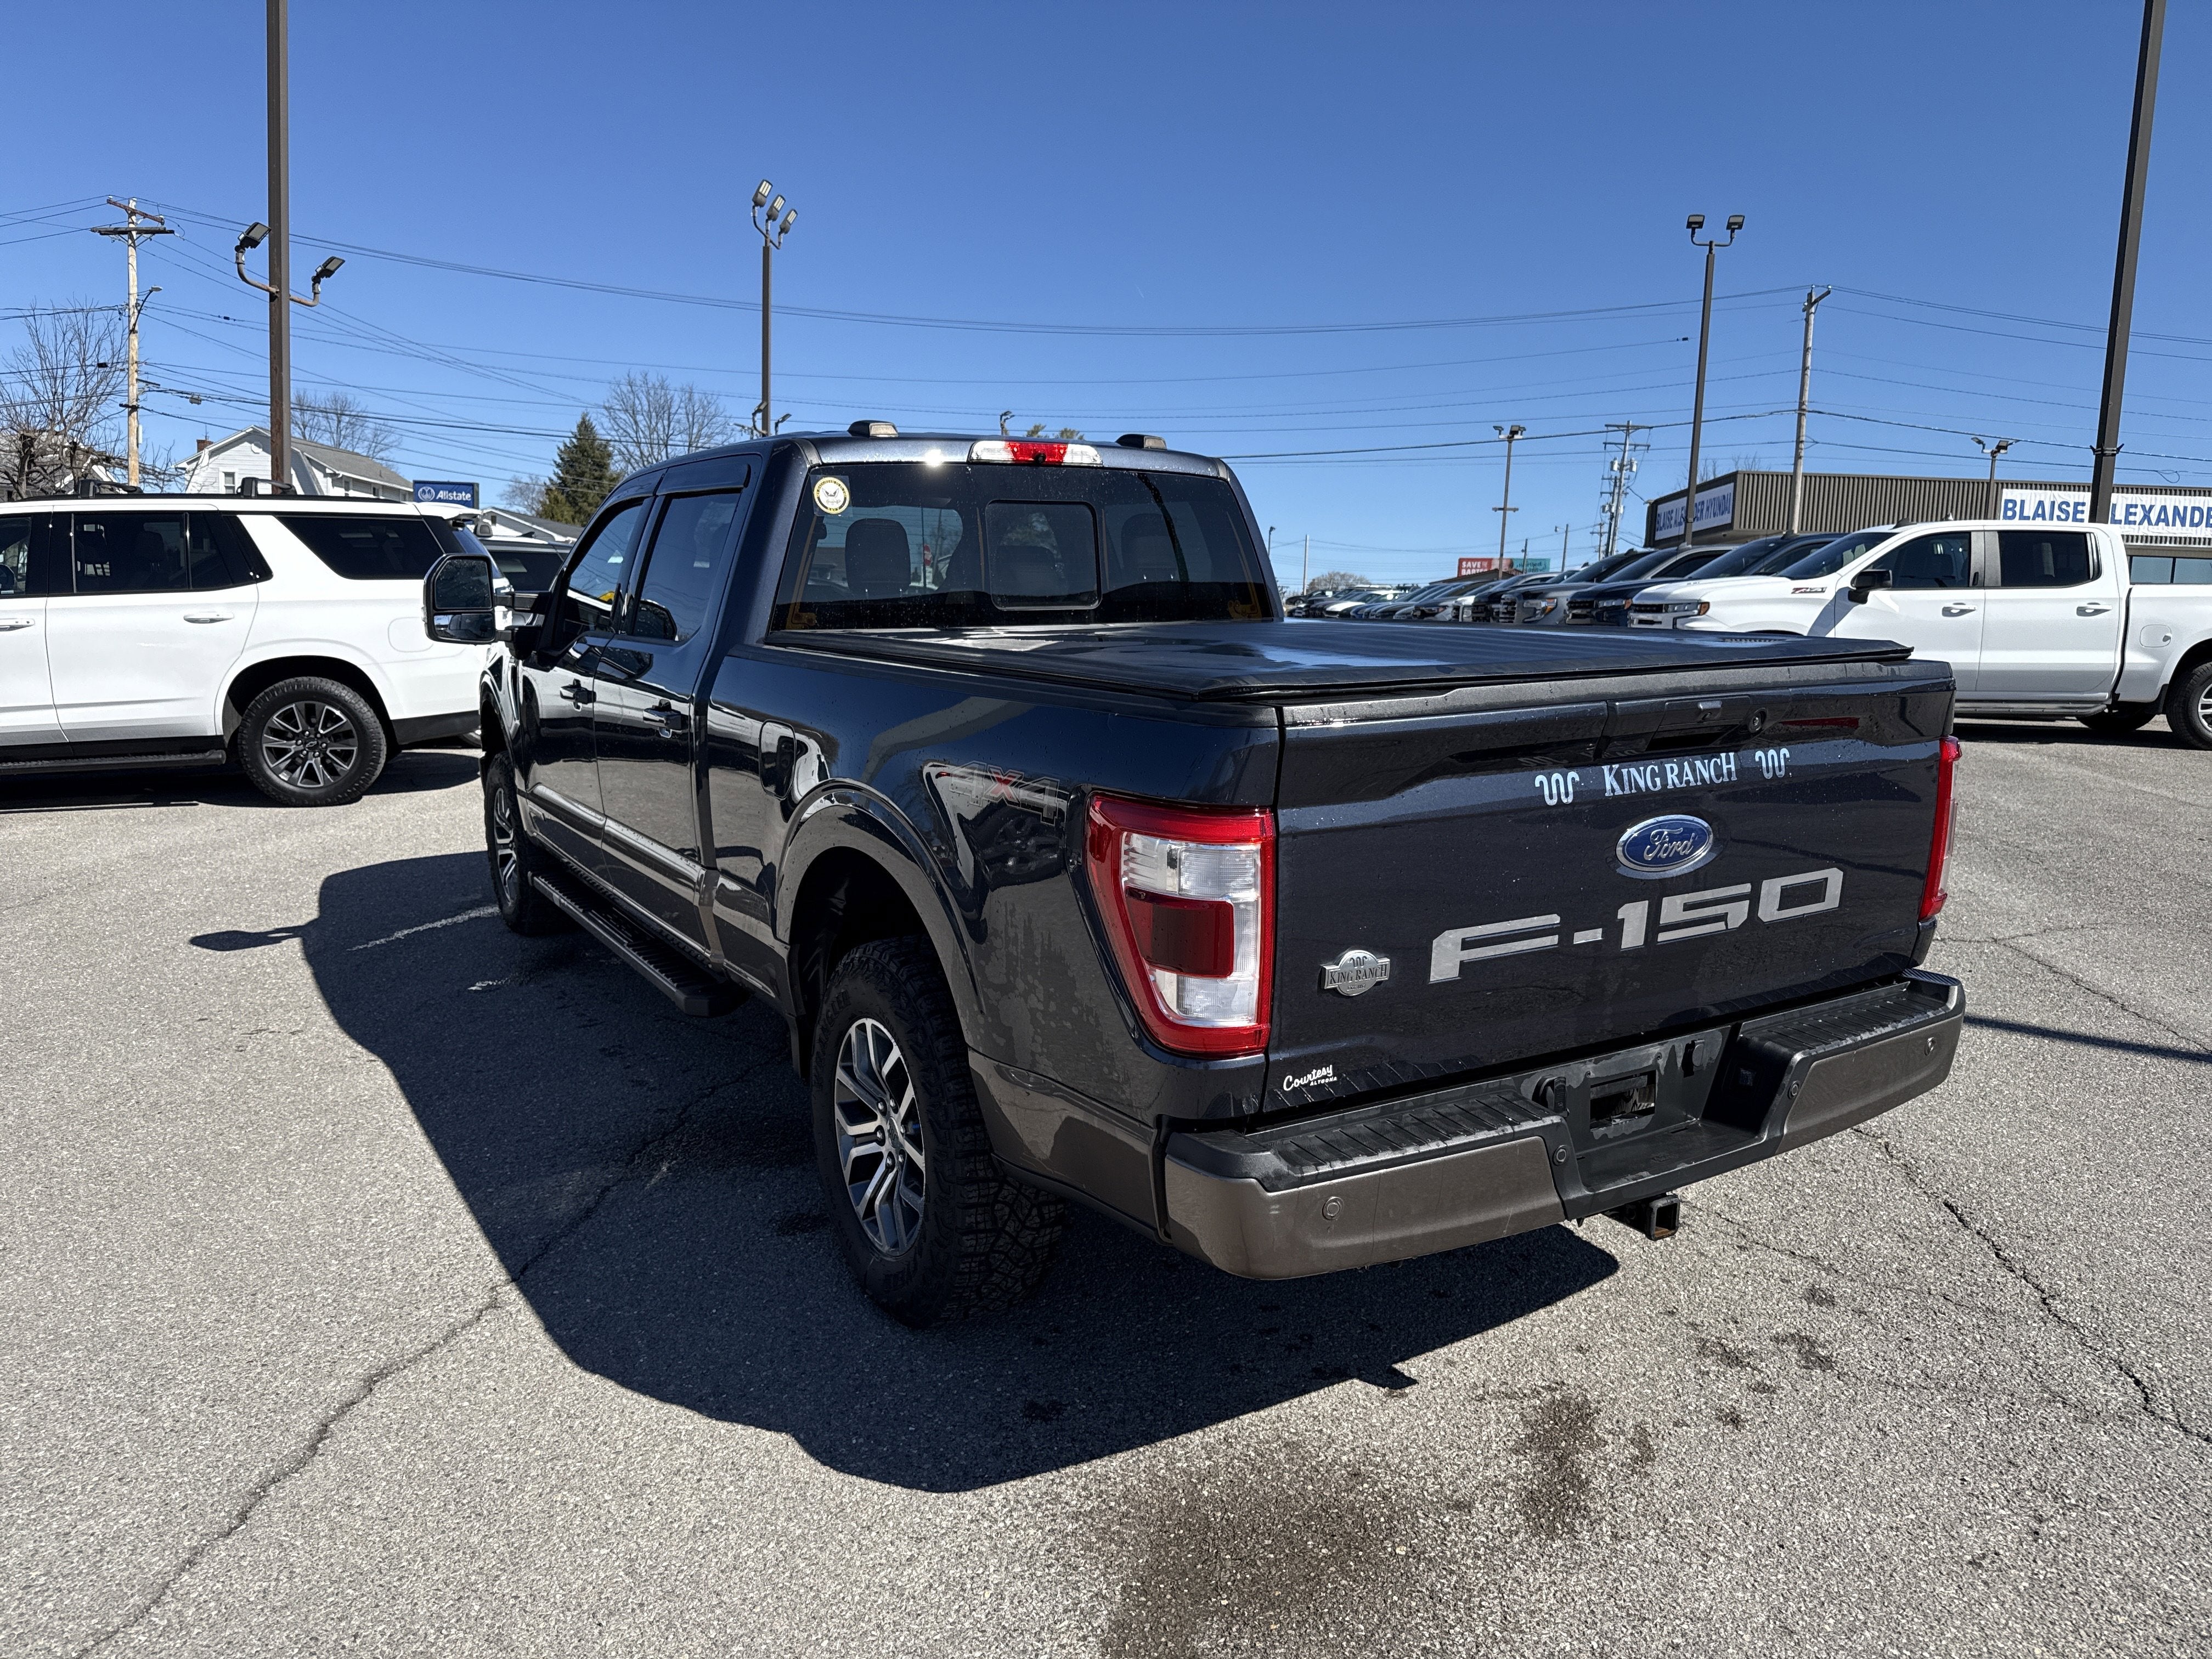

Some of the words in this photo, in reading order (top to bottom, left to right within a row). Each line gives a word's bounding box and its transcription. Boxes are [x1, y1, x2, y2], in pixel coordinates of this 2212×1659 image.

[436, 490, 471, 501] Allstate
[1656, 509, 1674, 532] BLAISE
[1673, 500, 1705, 527] ALEDER
[1705, 493, 1731, 520] HYUNDAI
[2002, 499, 2086, 523] BLAISE
[2110, 503, 2212, 528] LEXANDE
[1601, 764, 1662, 797] KING
[1664, 752, 1738, 789] RANCH
[1643, 827, 1695, 861] Ford
[1429, 867, 1844, 983] F-150
[1329, 970, 1353, 985] KING
[1355, 964, 1387, 982] RANCH
[1283, 1064, 1333, 1091] Courtesy
[1310, 1076, 1337, 1086] ALTOONA
